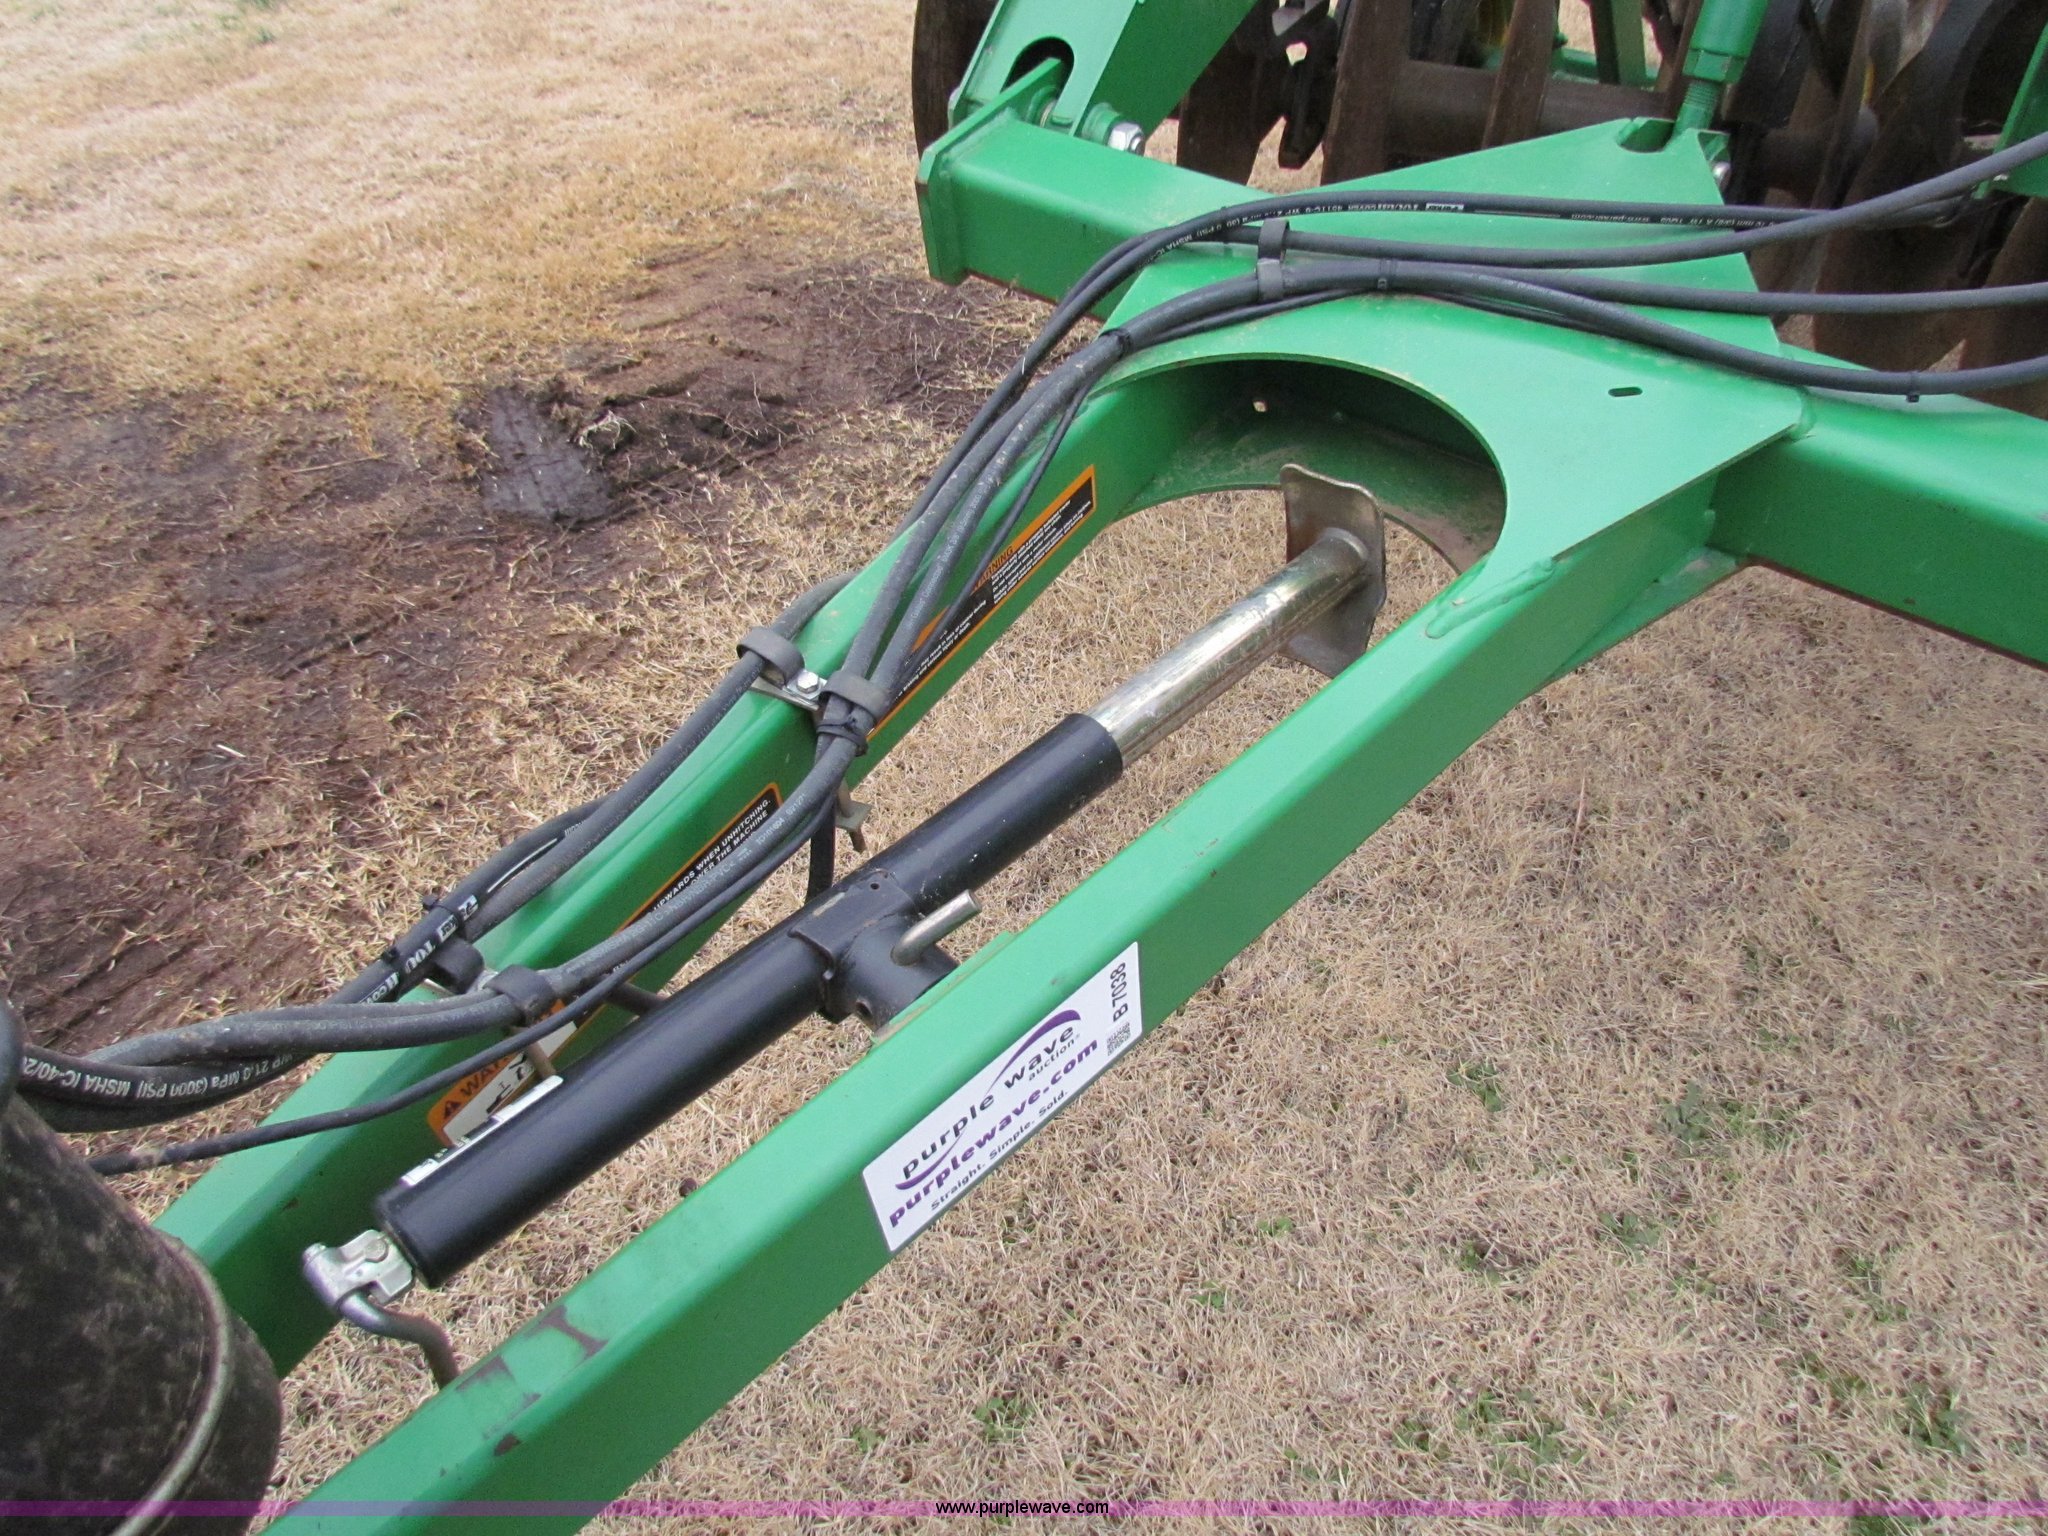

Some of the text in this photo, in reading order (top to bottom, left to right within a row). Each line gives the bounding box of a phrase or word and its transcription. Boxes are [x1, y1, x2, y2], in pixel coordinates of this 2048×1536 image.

[696, 845, 721, 871] WHEN
[721, 799, 772, 848] UNHITCHING.
[716, 845, 733, 863] THE
[733, 809, 769, 847] MACHINE
[1109, 962, 1129, 1023] B 7038
[83, 1073, 132, 1098] MSHA
[212, 1070, 240, 1089] MPa
[903, 1026, 1074, 1180] purple wave
[889, 1039, 1098, 1228] purplewave.com
[931, 1090, 1069, 1211] Straight. Simple. Sold.
